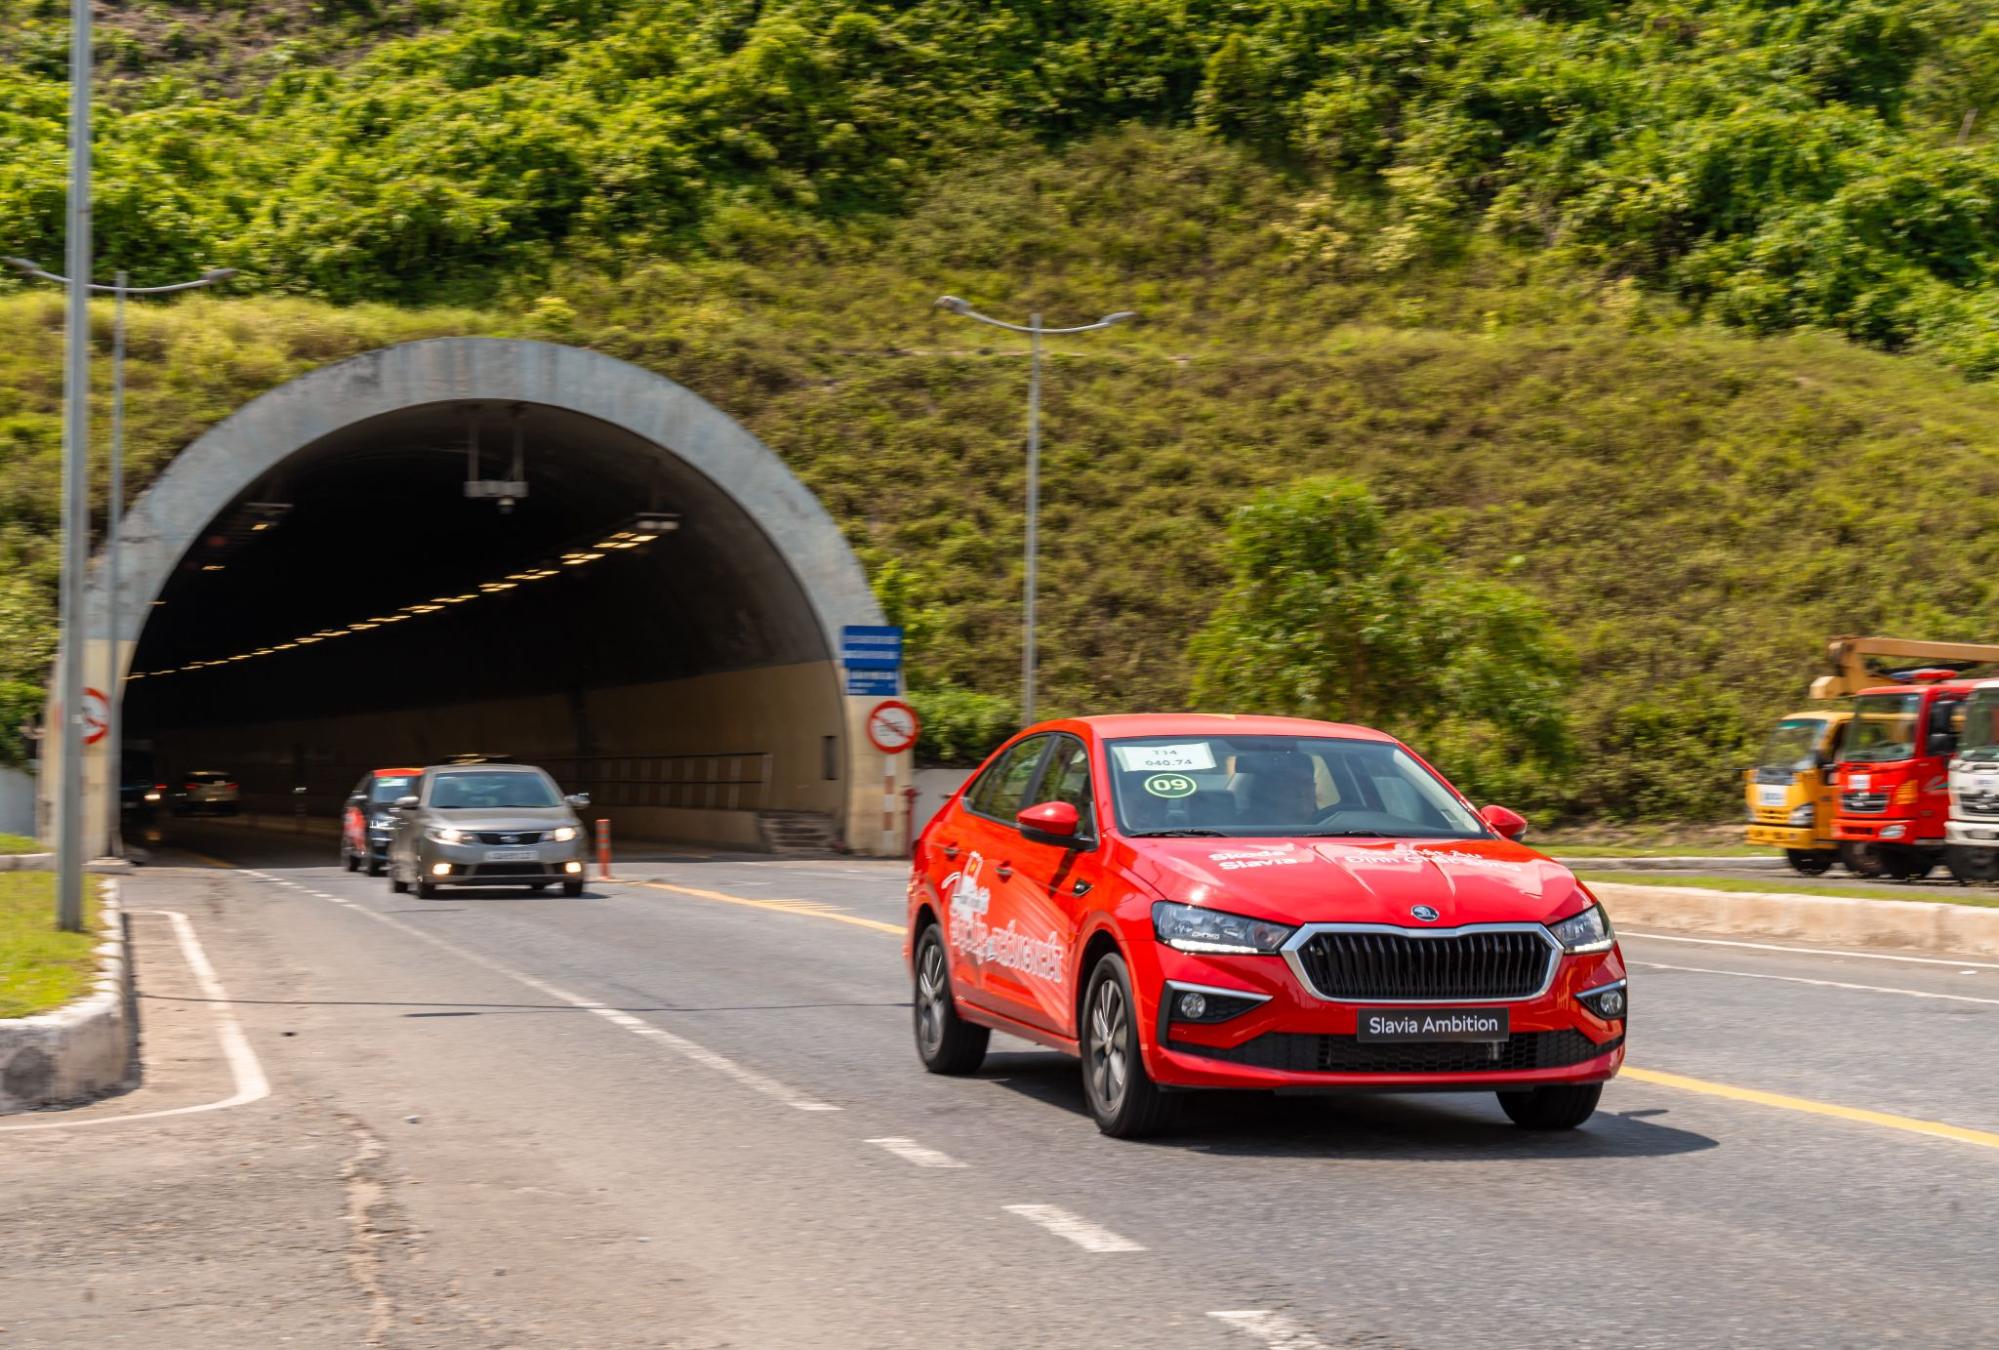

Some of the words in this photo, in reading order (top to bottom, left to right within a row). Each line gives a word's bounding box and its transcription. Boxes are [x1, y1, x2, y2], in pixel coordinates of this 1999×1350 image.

[1153, 779, 1188, 791] 09
[1219, 858, 1298, 870] Slavia
[1369, 1016, 1418, 1034] Slavia
[1422, 1015, 1499, 1033] Ambition
